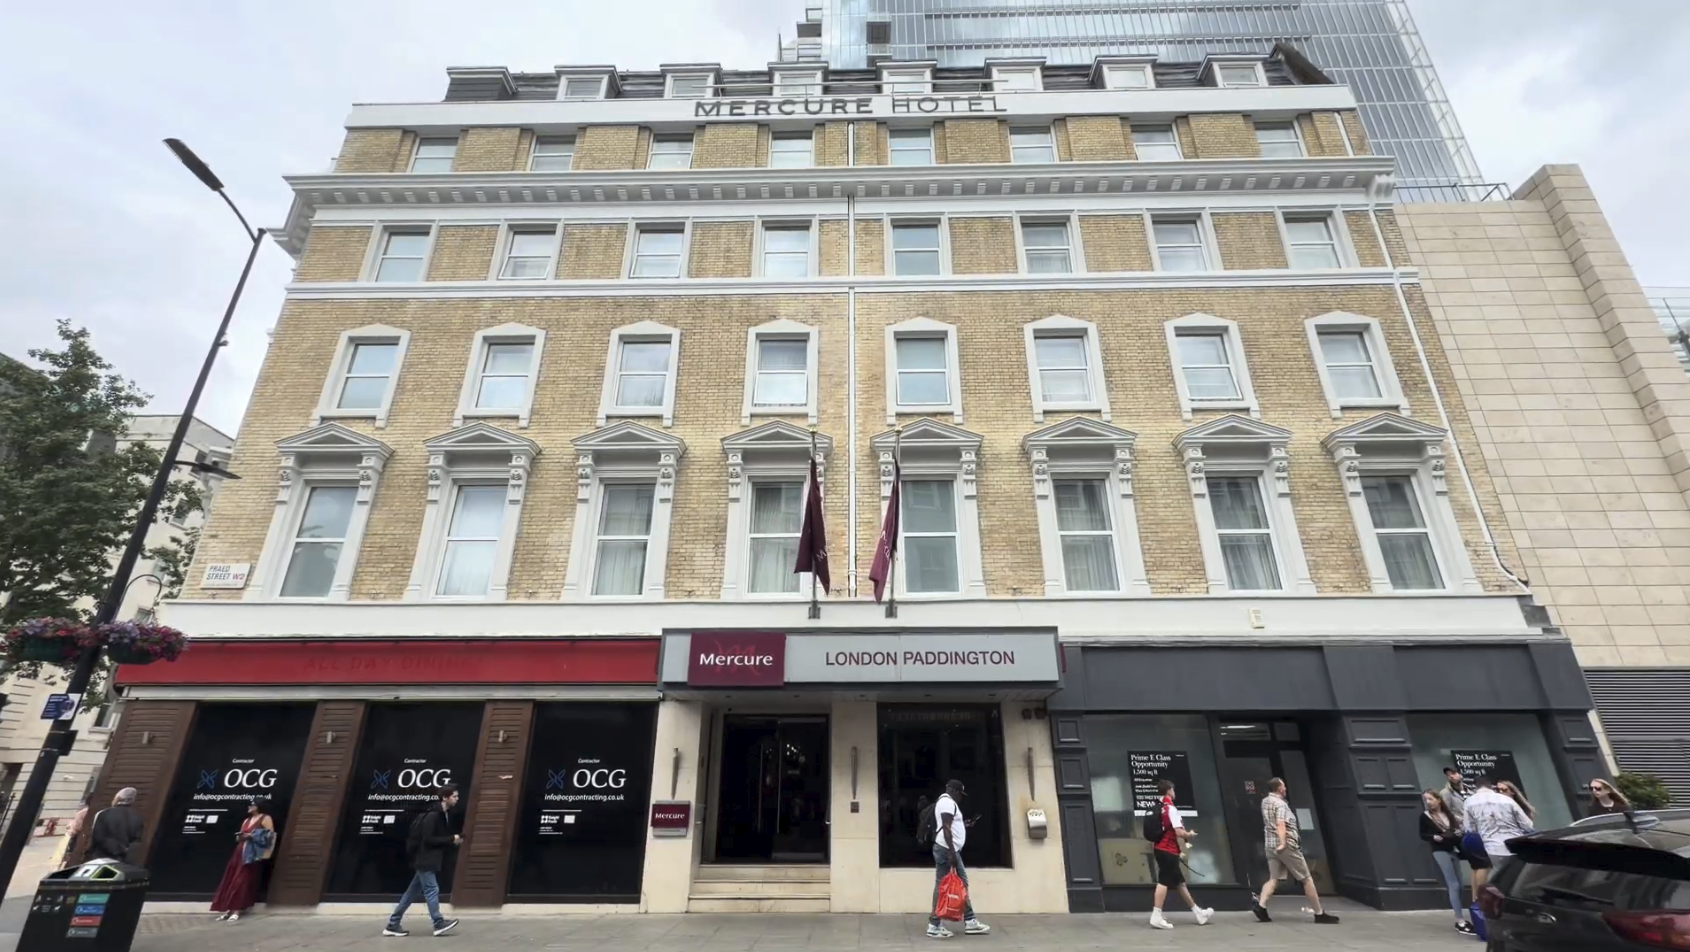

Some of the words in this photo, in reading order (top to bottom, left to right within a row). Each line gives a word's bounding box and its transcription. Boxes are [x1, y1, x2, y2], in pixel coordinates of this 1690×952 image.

[695, 97, 873, 117] MERCURE
[892, 96, 1007, 113] HOTEL
[209, 565, 231, 573] PRAED
[206, 572, 232, 580] STREET
[699, 653, 774, 666] Mercure
[825, 651, 898, 666] LONDON
[903, 651, 1015, 665] PADDINGTON
[1131, 760, 1168, 769] Opportunity
[1457, 760, 1495, 769] Opportunity
[224, 768, 278, 788] OCG
[397, 768, 451, 788] OCG
[573, 768, 627, 788] OCG
[368, 793, 439, 802] info@ocgcontracting.co.
[544, 793, 625, 802] info@ocgcontracting.co.uk
